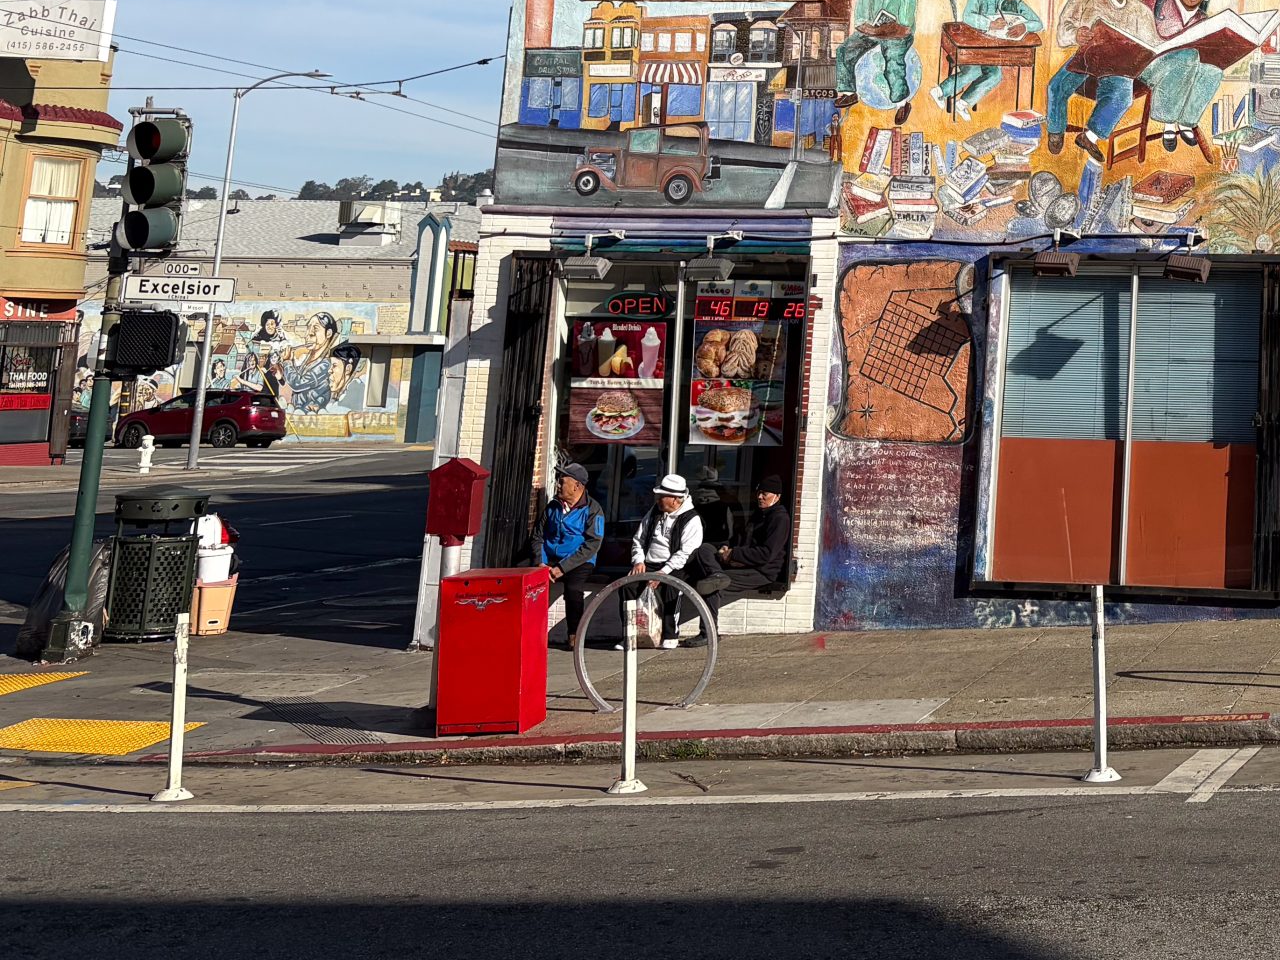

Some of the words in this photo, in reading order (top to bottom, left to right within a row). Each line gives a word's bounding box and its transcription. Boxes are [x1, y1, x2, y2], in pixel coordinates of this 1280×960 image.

[4, 6, 50, 26] Zabb
[58, 6, 97, 30] Thai
[20, 25, 76, 38] Cuisine
[6, 40, 32, 51] (415)
[35, 41, 85, 52] 586-2455
[892, 183, 925, 191] LIBRES
[896, 212, 927, 222] BIBLIA
[166, 264, 189, 274] 000
[139, 279, 220, 296] Excelsior
[4, 301, 49, 319] SINE
[608, 297, 666, 315] OPEN
[710, 300, 732, 317] 46
[753, 301, 770, 317] 19
[783, 302, 806, 318] 26
[9, 372, 27, 381] THAI
[28, 371, 48, 381] FOOD
